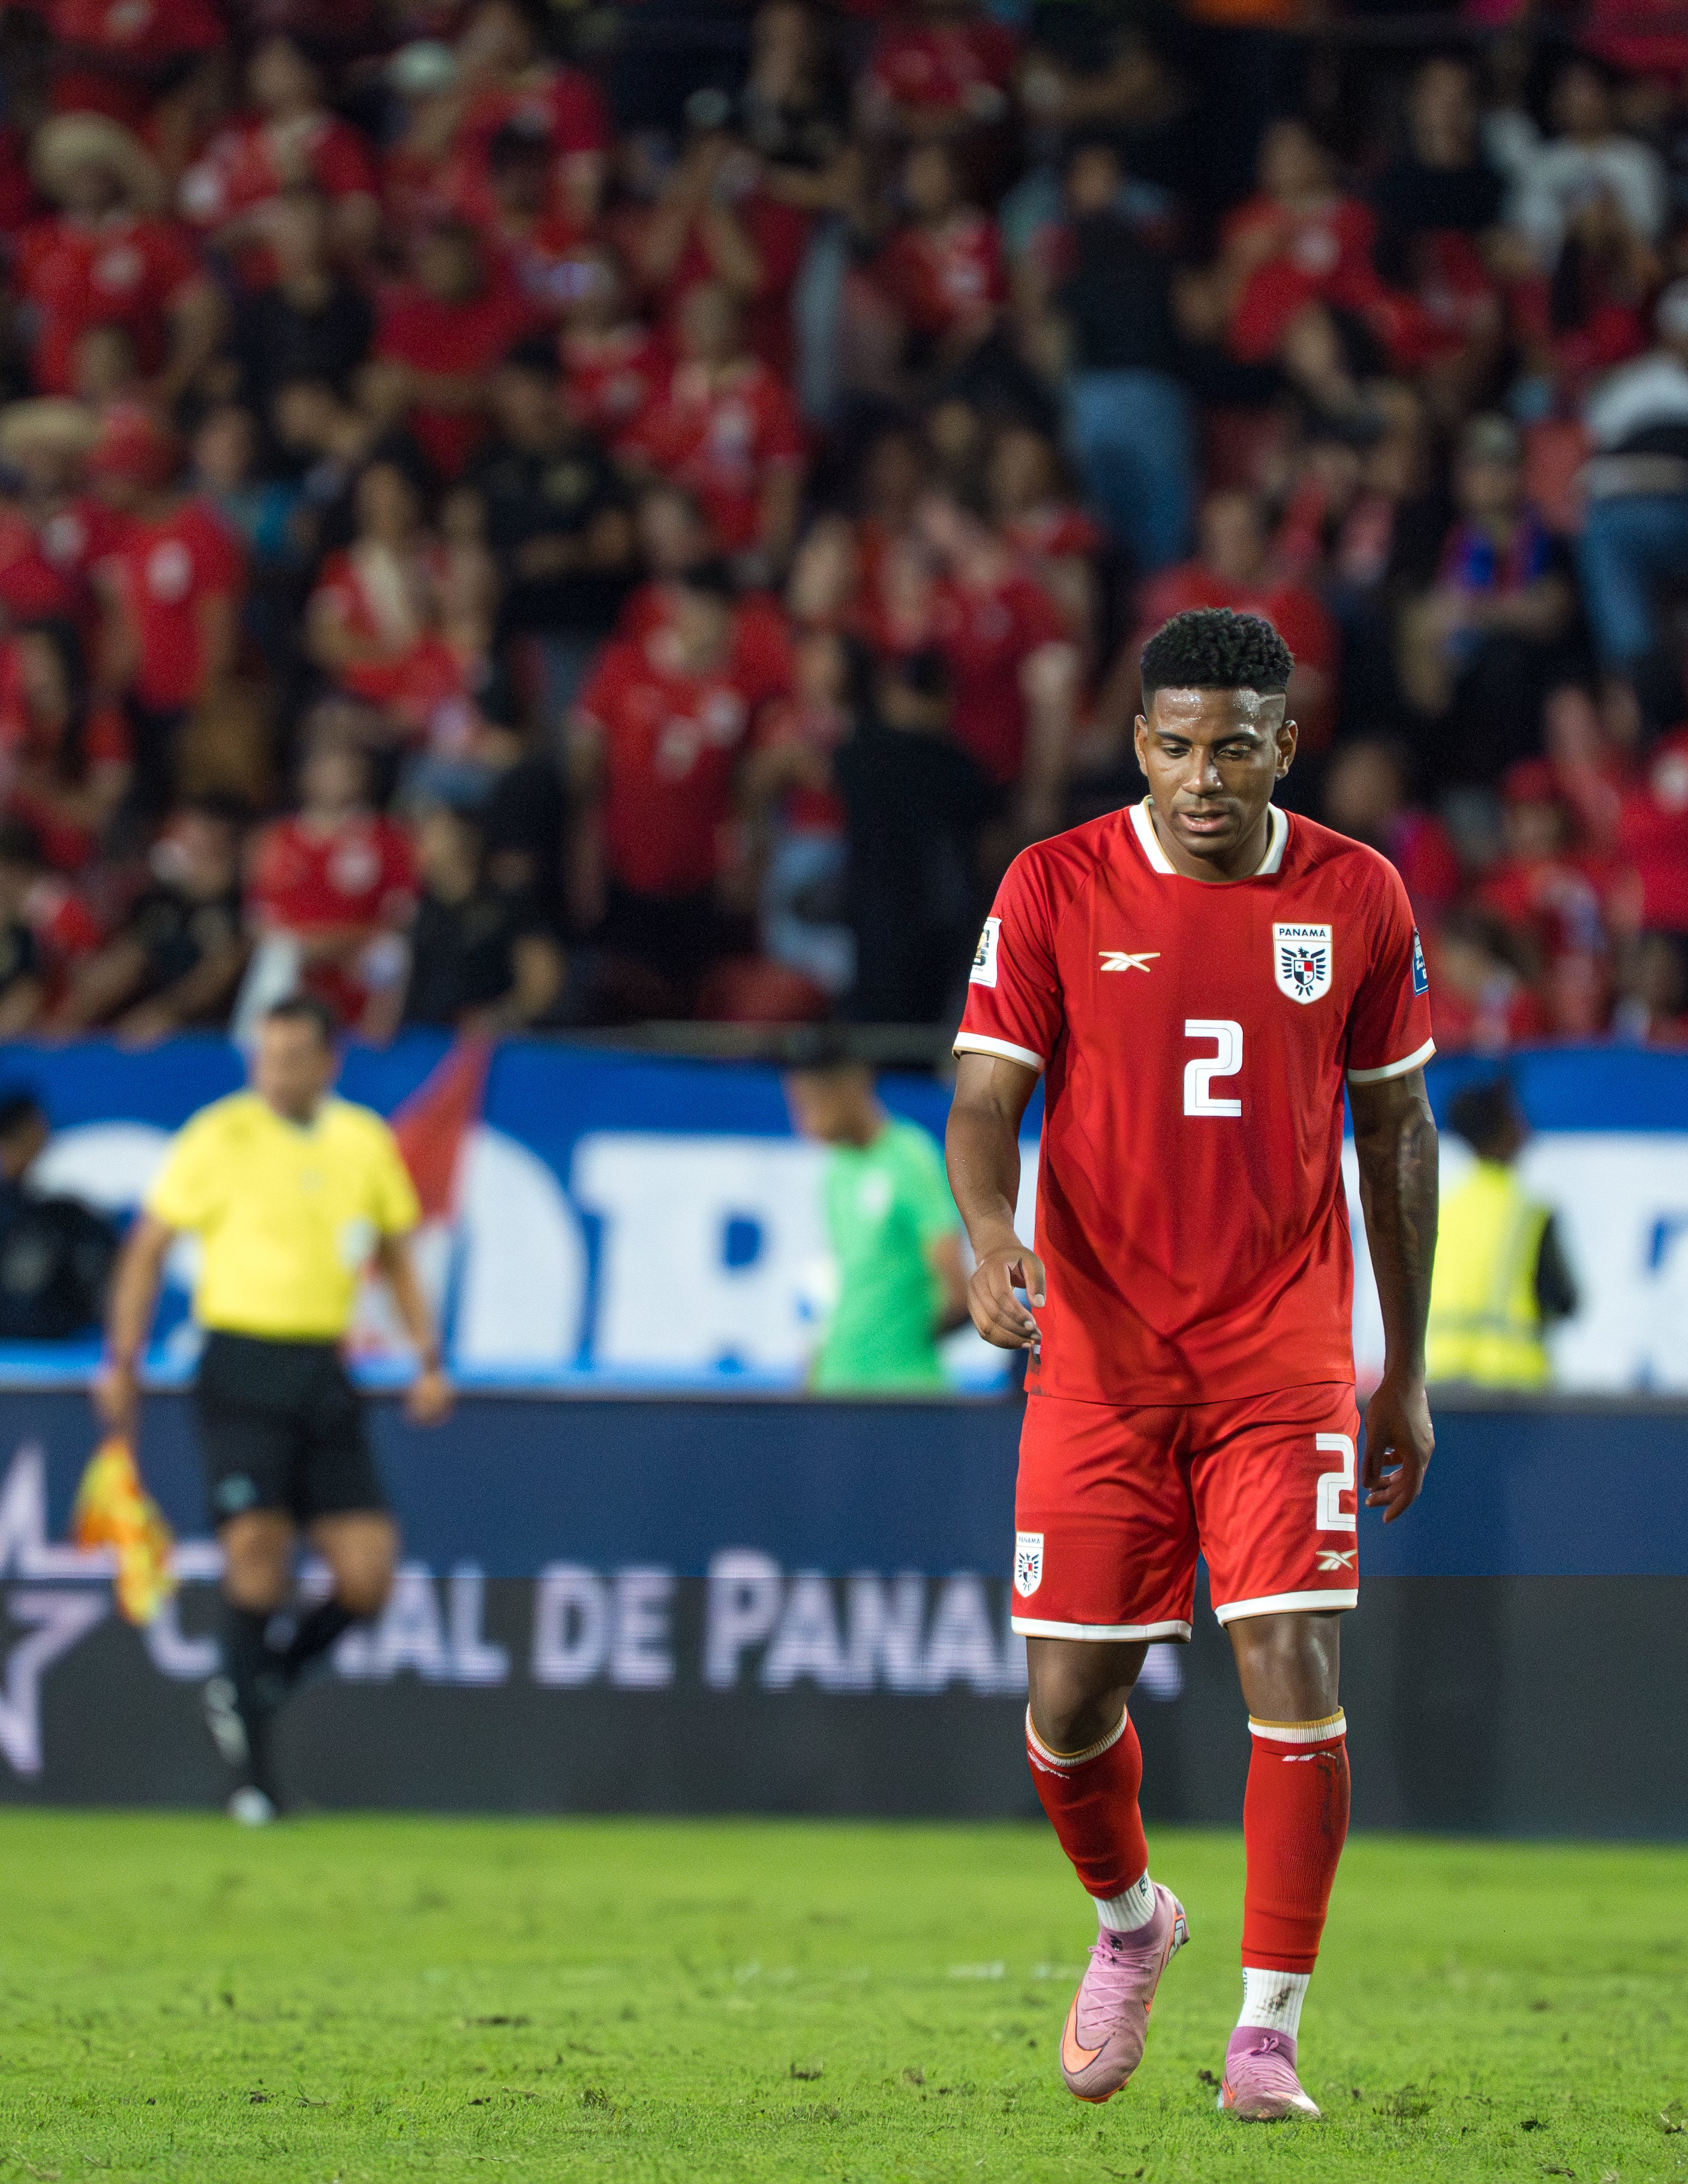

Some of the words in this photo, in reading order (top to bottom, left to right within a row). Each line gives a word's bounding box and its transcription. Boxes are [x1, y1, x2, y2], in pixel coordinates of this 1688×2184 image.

[1279, 927, 1326, 937] PANAMÁ
[1184, 1019, 1244, 1117] 2
[1315, 1432, 1356, 1532] 2
[533, 1561, 677, 1689] DE
[704, 1545, 1183, 1701] PANA
